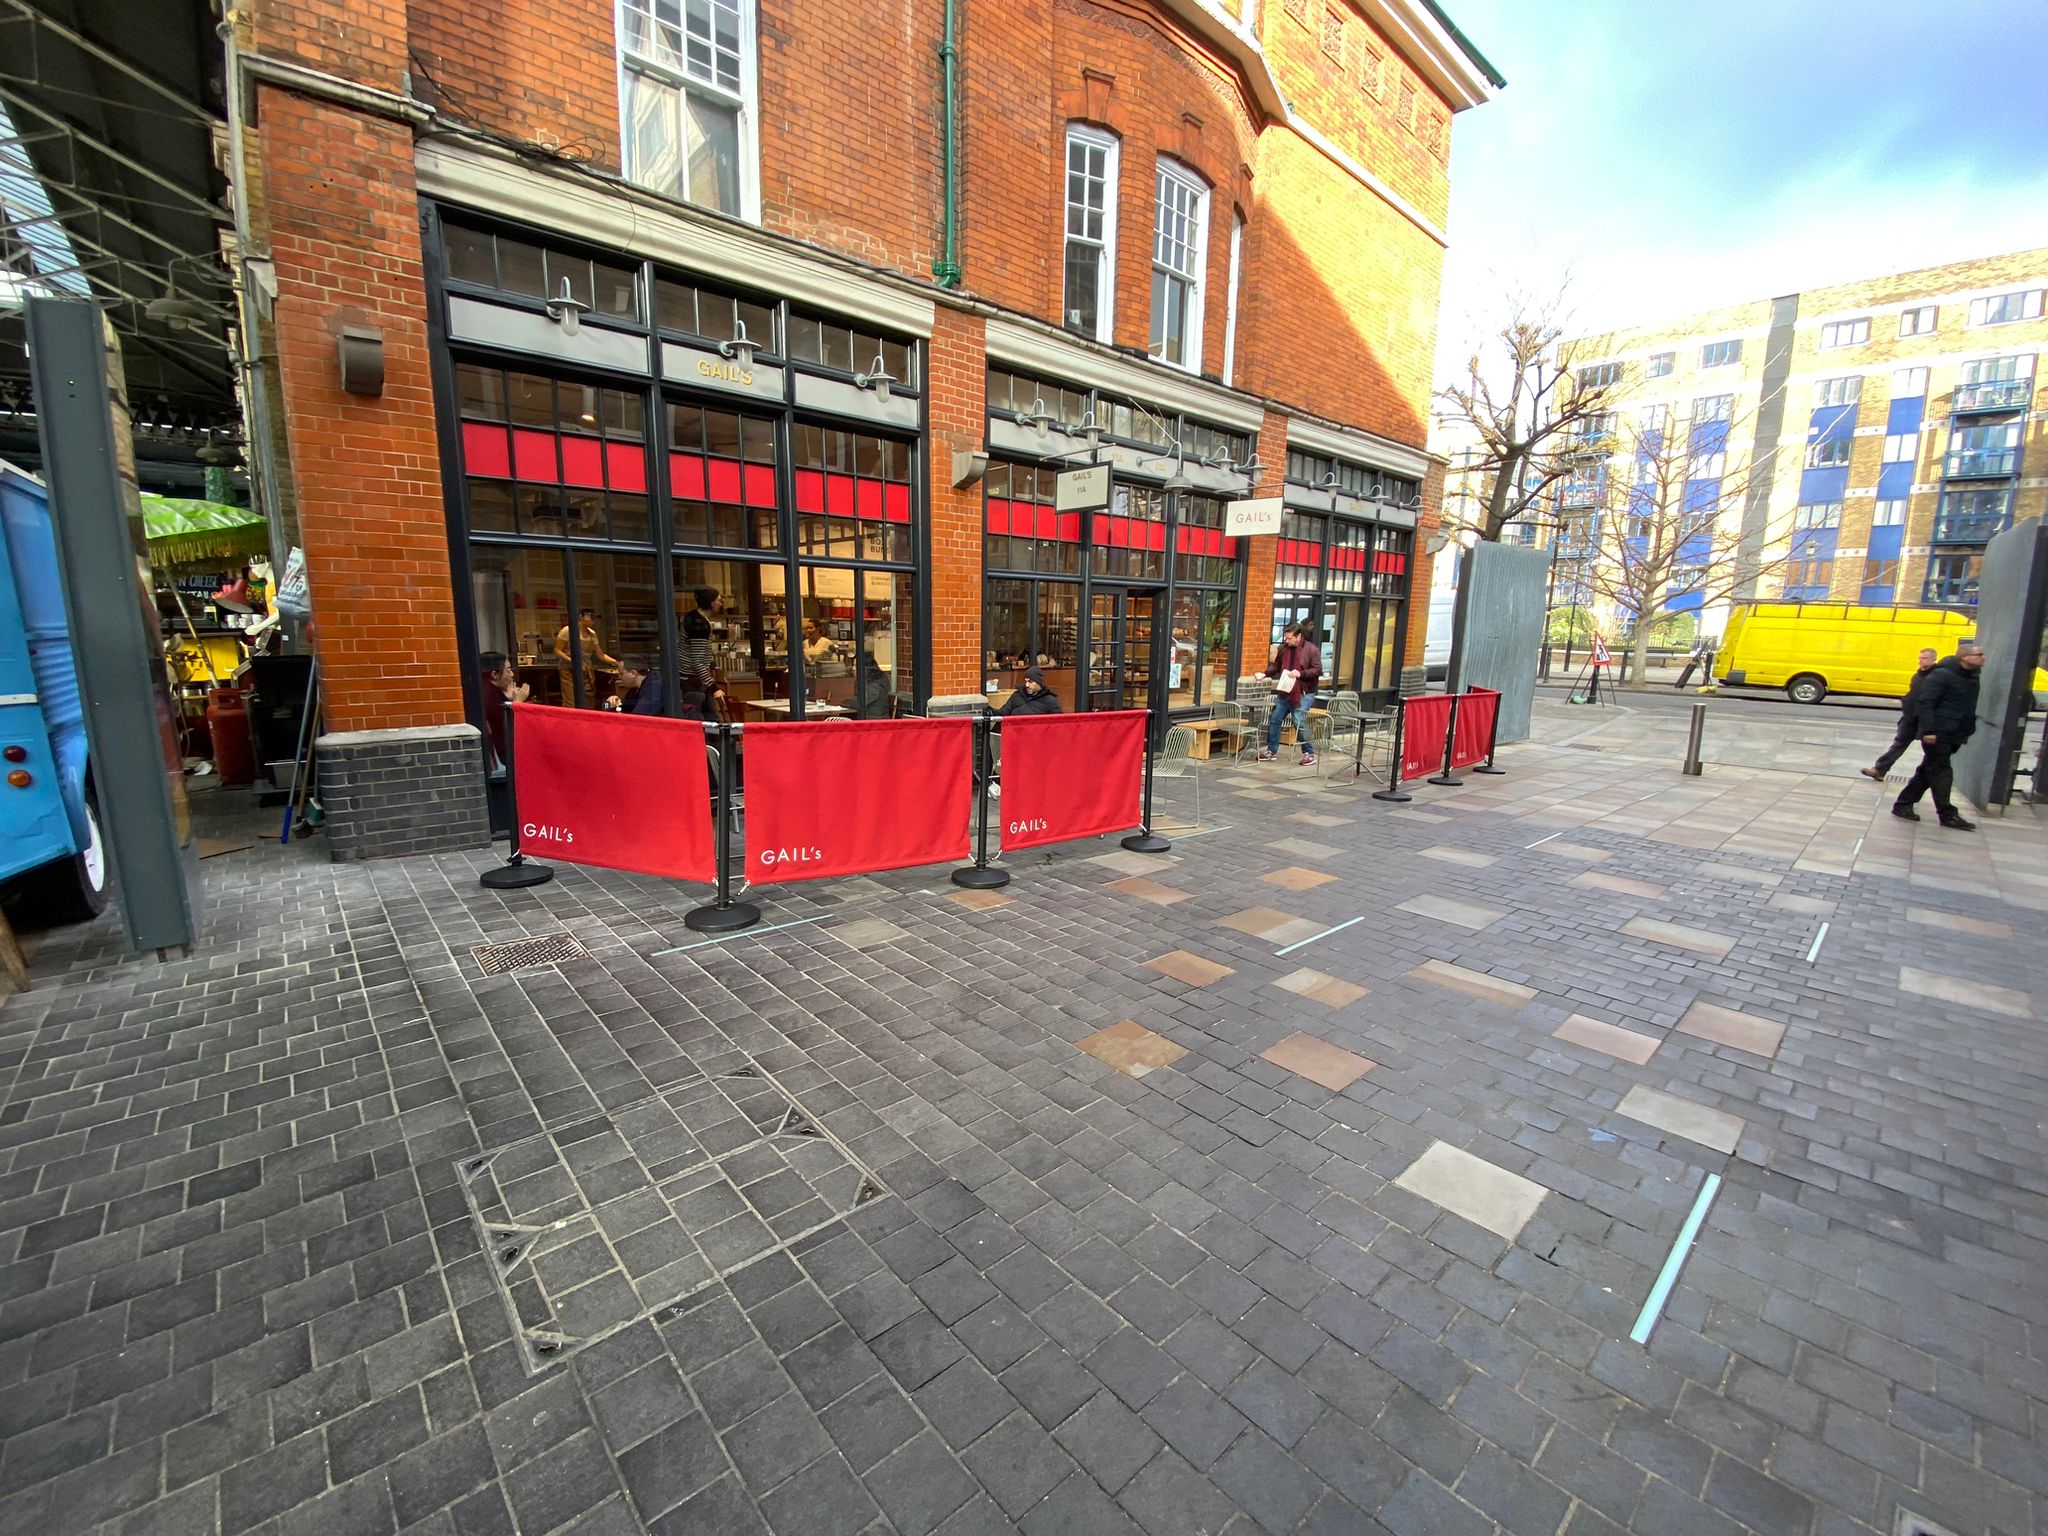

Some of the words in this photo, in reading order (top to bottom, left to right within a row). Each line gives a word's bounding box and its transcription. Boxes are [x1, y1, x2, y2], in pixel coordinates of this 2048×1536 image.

[697, 359, 753, 385] GAIL'S
[1235, 511, 1271, 524] GAIL's
[523, 822, 574, 844] GAIL's
[1009, 817, 1048, 835] GAIL's
[760, 846, 822, 866] GAIL's
